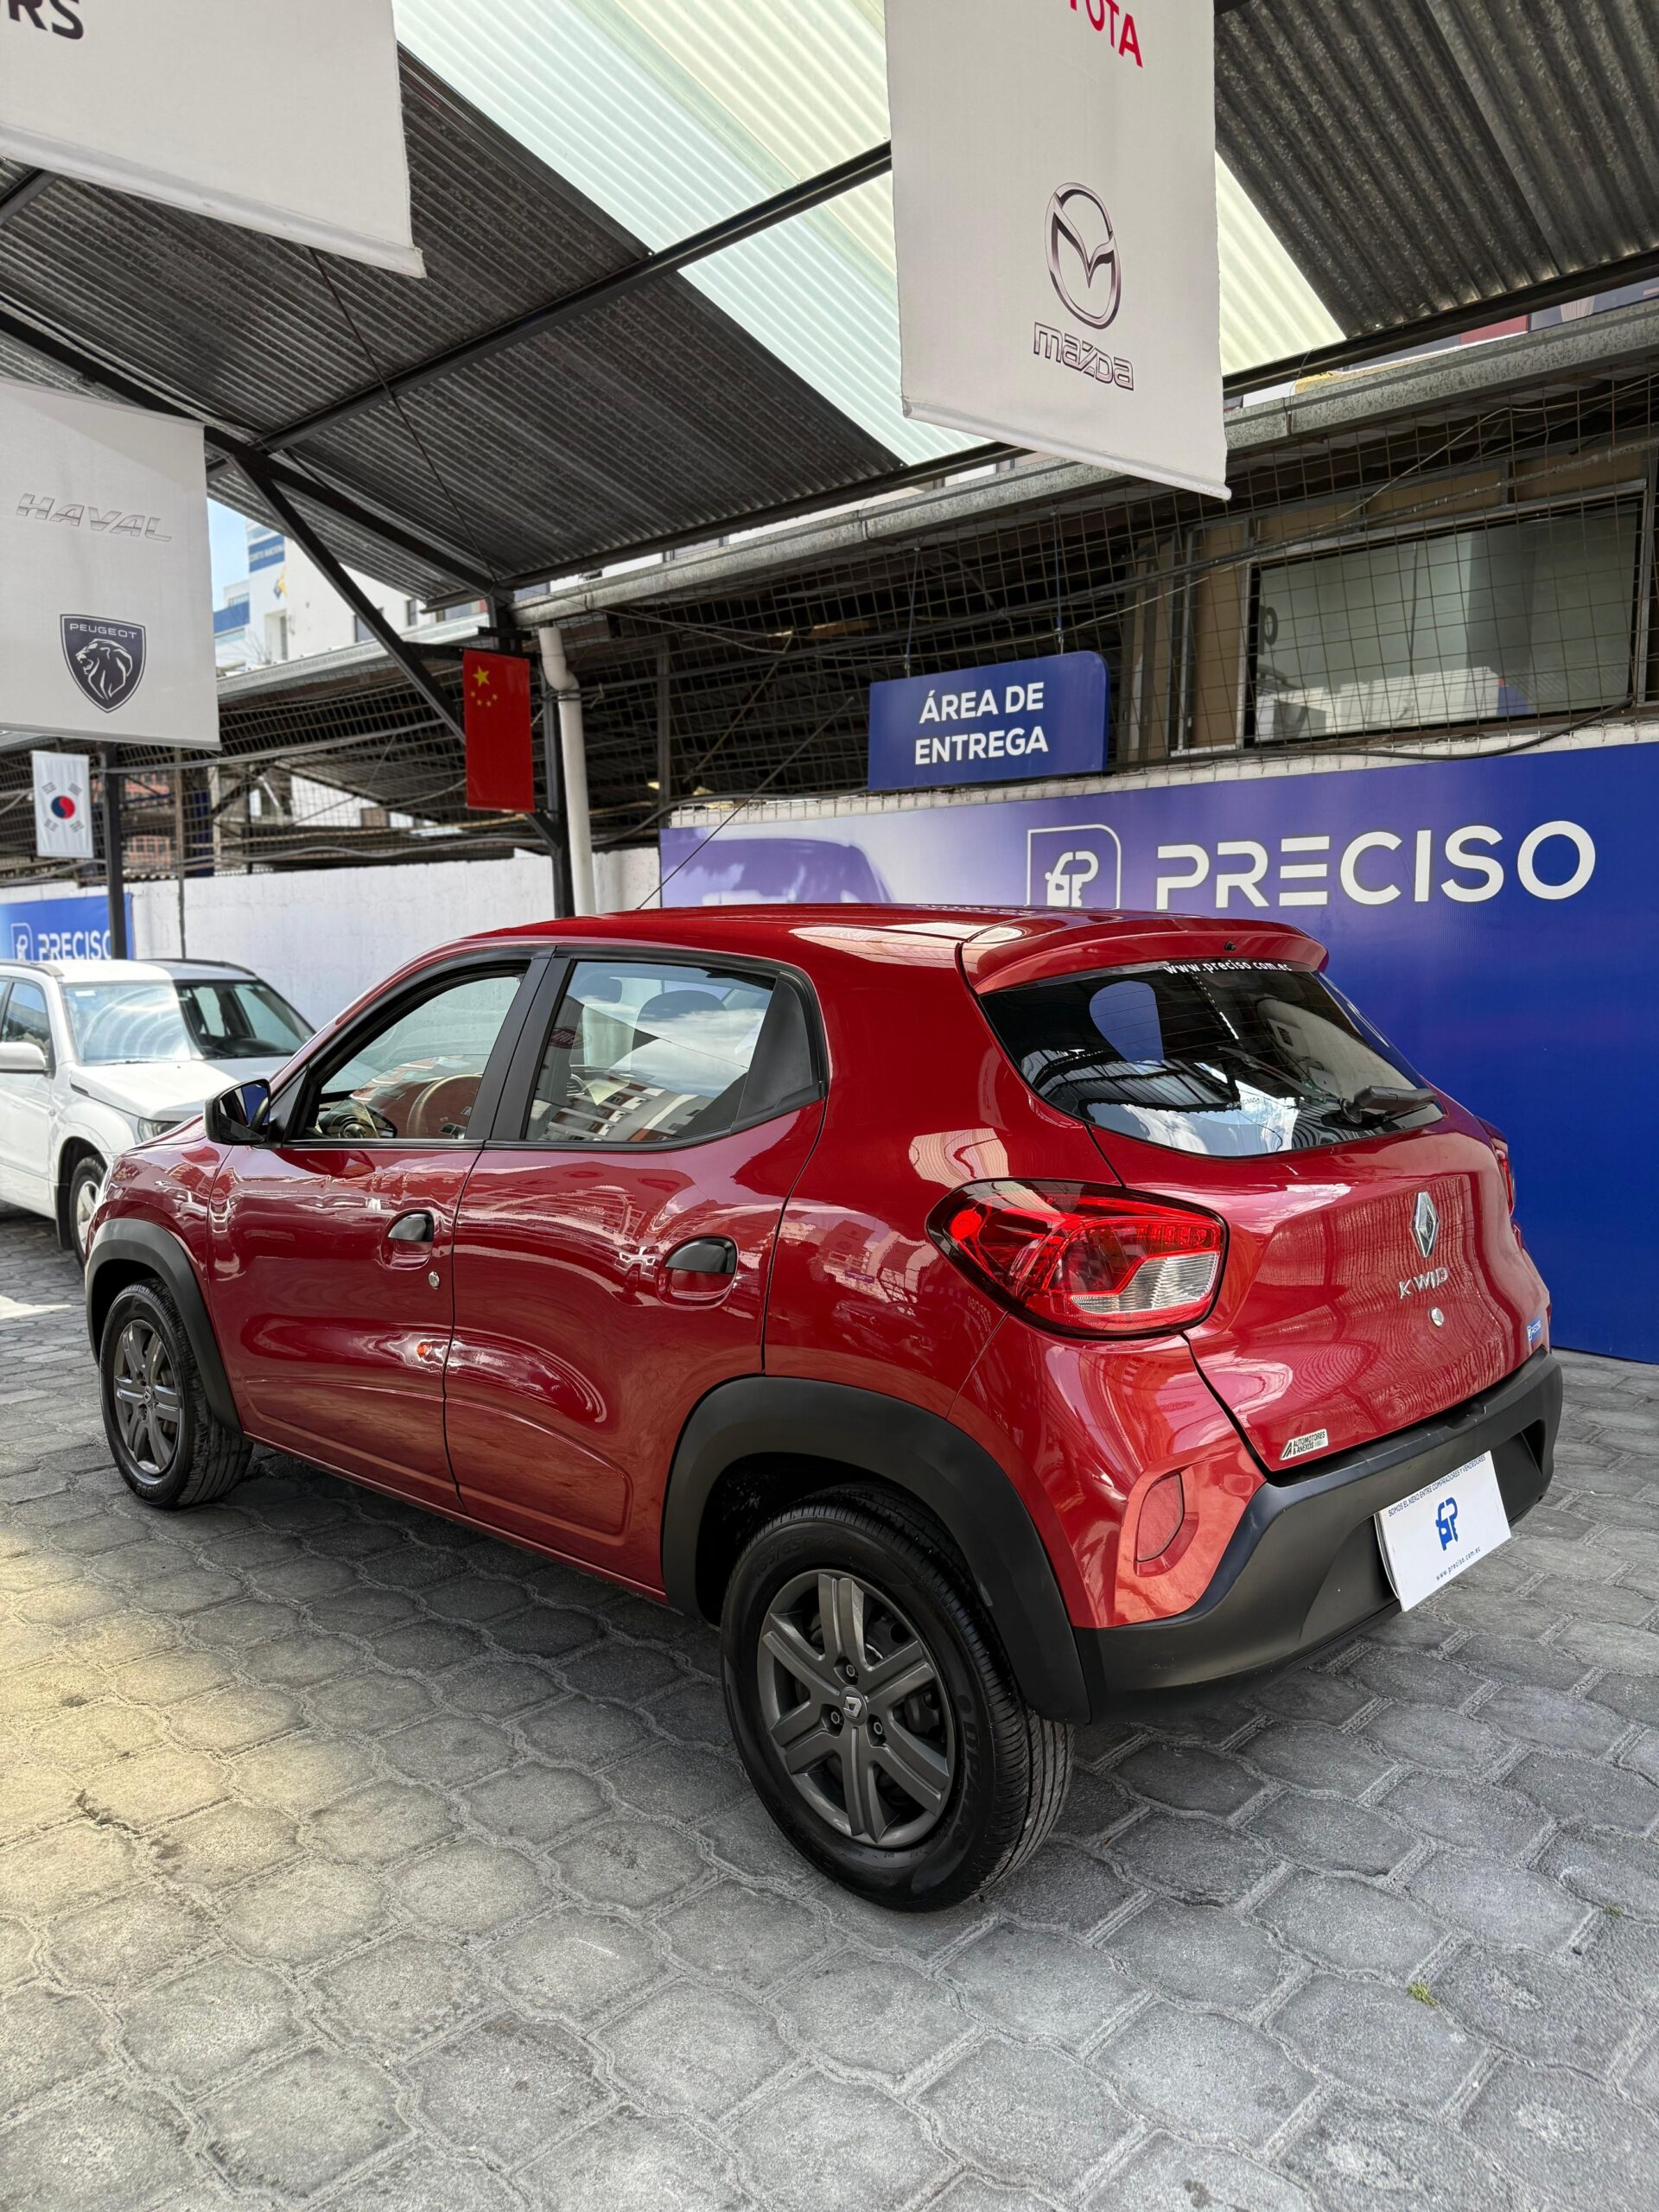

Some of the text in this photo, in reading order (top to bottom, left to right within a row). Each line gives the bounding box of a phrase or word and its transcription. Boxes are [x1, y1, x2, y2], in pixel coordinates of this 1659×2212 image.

[1070, 0, 1143, 68] OTA
[16, 493, 173, 543] HAVAL
[69, 623, 137, 639] PEUGEOT
[918, 682, 1045, 724] ÁREA DE
[915, 726, 1049, 766] ENTREGA
[1156, 820, 1596, 911] PRECISO
[1398, 1267, 1449, 1299] KWID
[1293, 1431, 1325, 1447] AUTOMOTORES
[1388, 1503, 1404, 1517] SOMOS
[1408, 1493, 1420, 1505] NEXO
[1420, 1485, 1433, 1498] ENTRE
[1432, 1469, 1460, 1491] COMPRADORES
